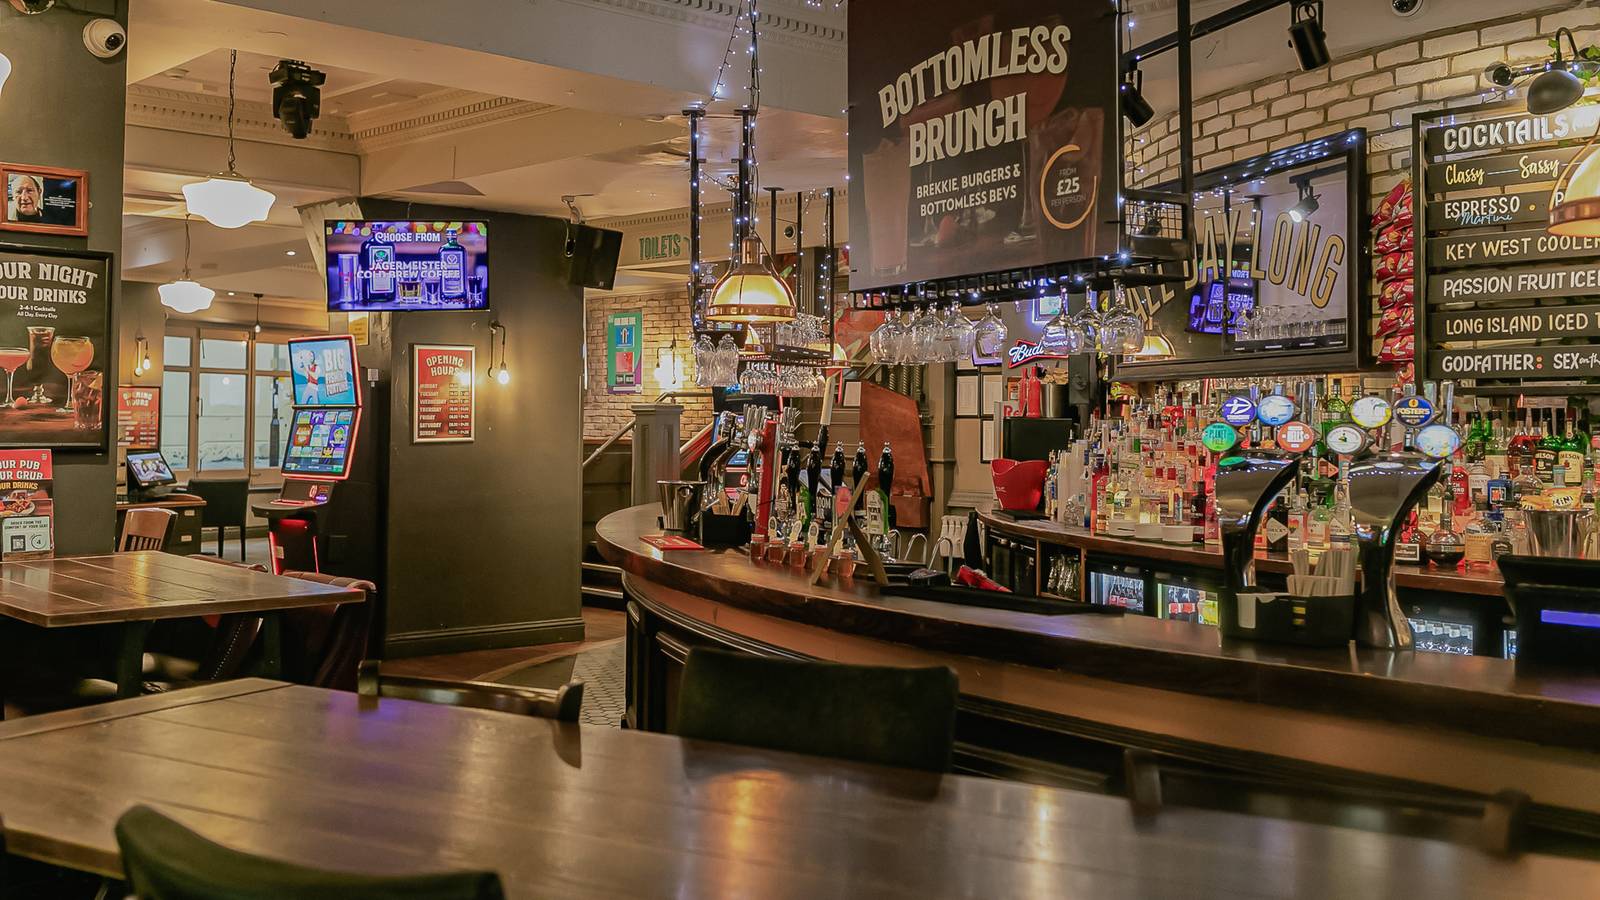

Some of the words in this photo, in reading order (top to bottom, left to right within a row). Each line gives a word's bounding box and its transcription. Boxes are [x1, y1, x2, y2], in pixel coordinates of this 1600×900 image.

[878, 25, 1071, 128] BOTTOMLESS
[909, 92, 1027, 168] BRUNCH
[1443, 114, 1569, 152] COCKTAILS
[916, 177, 960, 199] BREKKIE,
[961, 167, 1010, 189] BURGERS
[1012, 163, 1021, 178] &
[1445, 163, 1485, 185] Classy
[1519, 155, 1560, 179] Sassy
[1056, 176, 1080, 196] £25
[920, 195, 987, 217] BOTTOMLESS
[989, 185, 1017, 203] BEVS
[1444, 195, 1520, 220] ESPRESSO
[375, 232, 412, 243] CHOOSE
[415, 233, 441, 242] FROM
[640, 233, 681, 260] TOILETS
[1446, 242, 1476, 261] KEY
[1482, 237, 1531, 258] WEST
[1251, 210, 1345, 309] LONG
[38, 262, 98, 289] NIGHT
[357, 270, 388, 279] COLD
[389, 270, 418, 278] BREW
[421, 270, 460, 278] COFFEE
[1443, 276, 1512, 298] PASSION
[1518, 272, 1566, 292] FRUIT
[1570, 270, 1600, 288] ICE
[33, 287, 87, 305] DRINKS
[1446, 318, 1484, 335] LONG
[1487, 315, 1542, 335] ISLAND
[1549, 313, 1588, 331] ICED
[426, 355, 464, 367] OPENING
[431, 366, 460, 377] HOURS
[1553, 352, 1580, 370] SEX
[0, 460, 16, 469] UR
[20, 459, 40, 470] PUB
[12, 481, 39, 490] DRINKS
